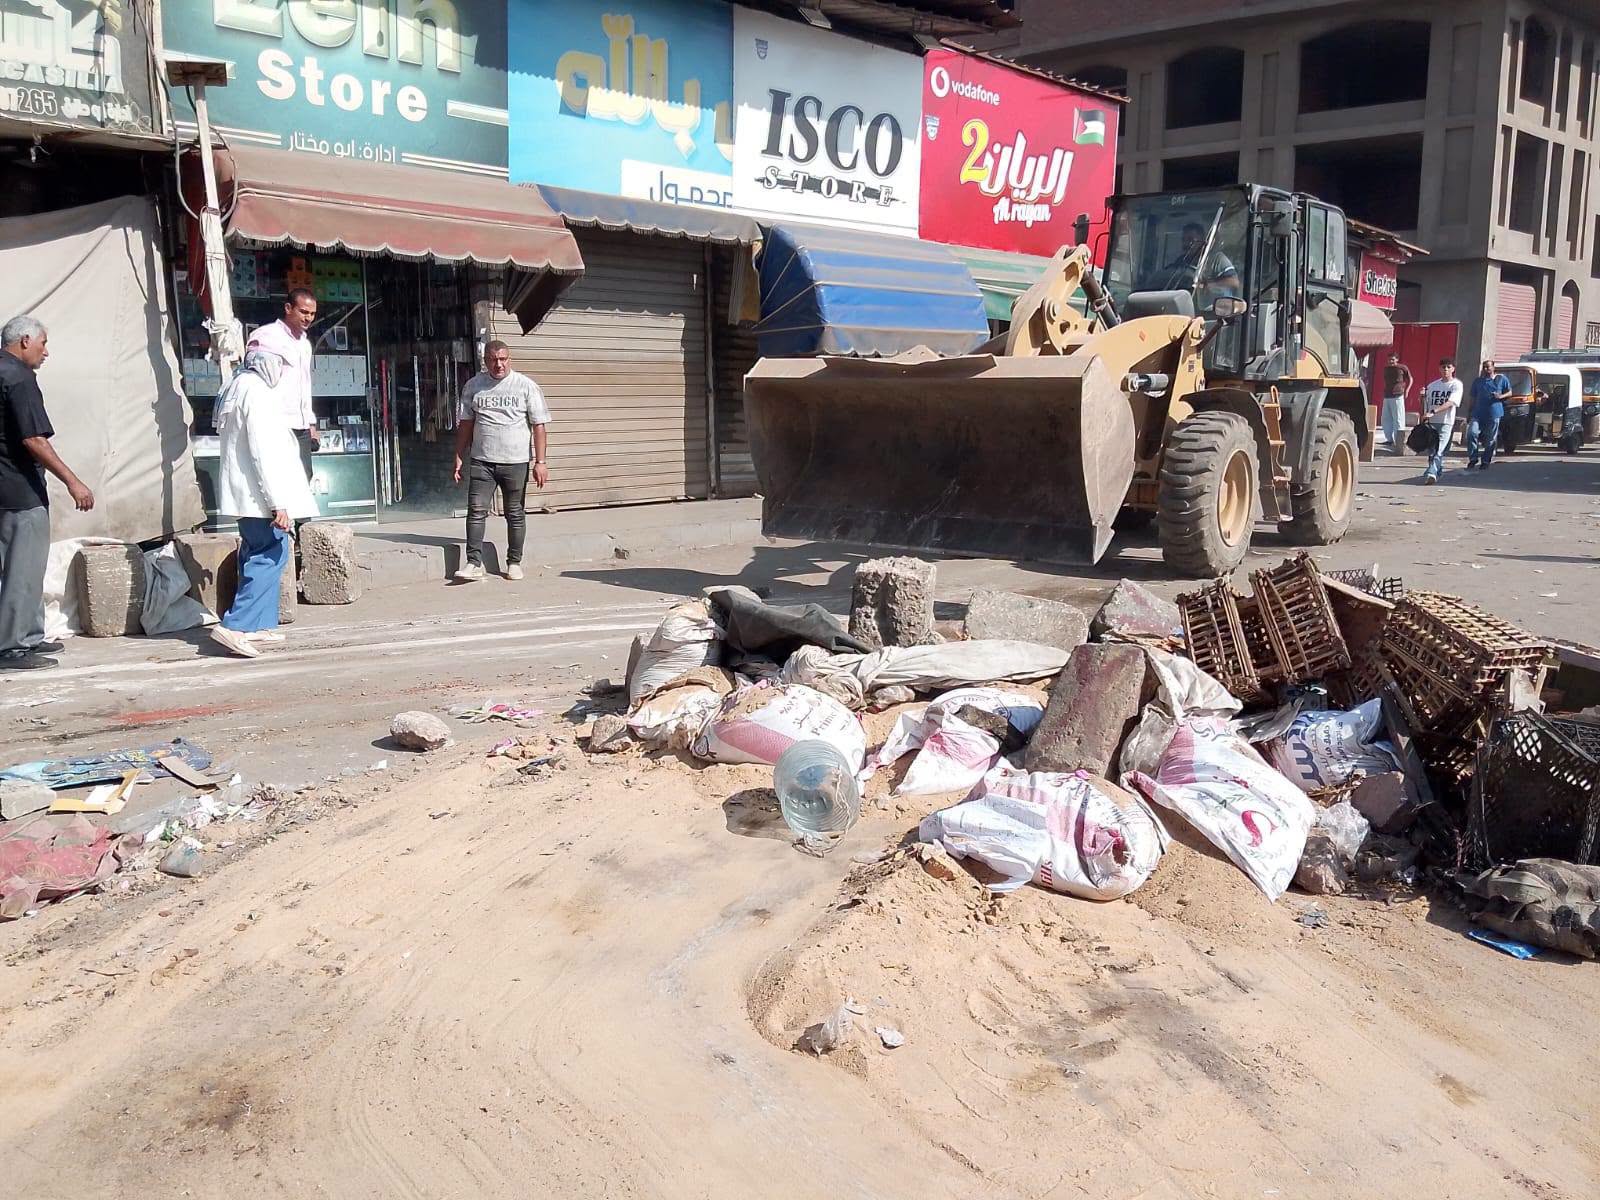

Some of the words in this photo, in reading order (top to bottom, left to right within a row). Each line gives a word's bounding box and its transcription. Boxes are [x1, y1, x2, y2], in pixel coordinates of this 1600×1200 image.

[257, 48, 428, 122] Store
[951, 80, 1000, 106] vodafone
[287, 131, 330, 155] مختار
[761, 88, 903, 177] ISCO
[959, 118, 989, 185] 2
[763, 166, 893, 207] STORE
[979, 130, 1075, 205] الريان
[477, 396, 519, 408] DESIGN
